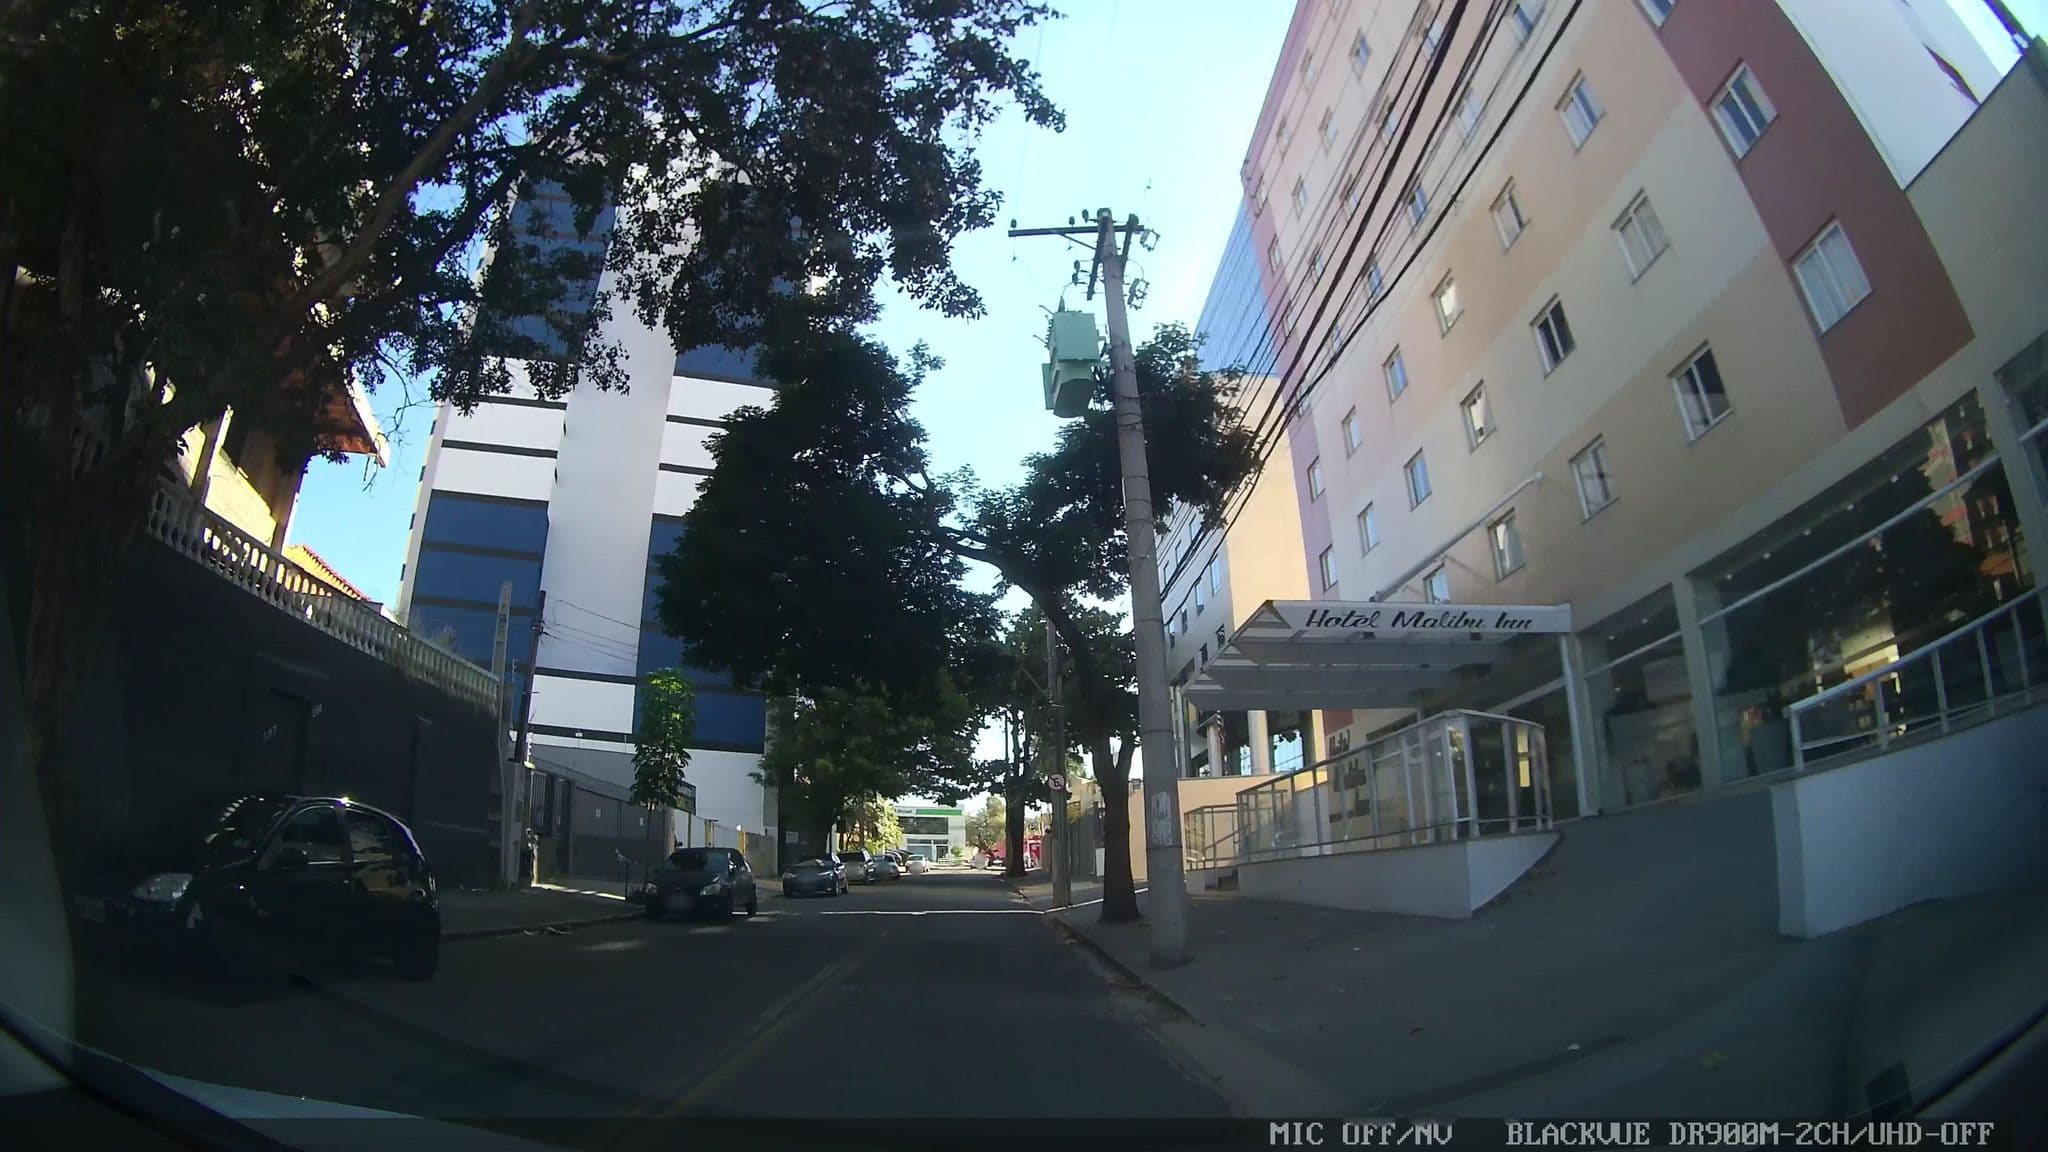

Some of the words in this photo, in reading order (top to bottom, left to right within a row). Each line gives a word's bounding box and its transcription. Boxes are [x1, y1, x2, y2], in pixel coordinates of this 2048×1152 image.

[1305, 609, 1381, 628] Hotel
[1391, 610, 1487, 629] Malibu
[1494, 611, 1533, 629] Inn
